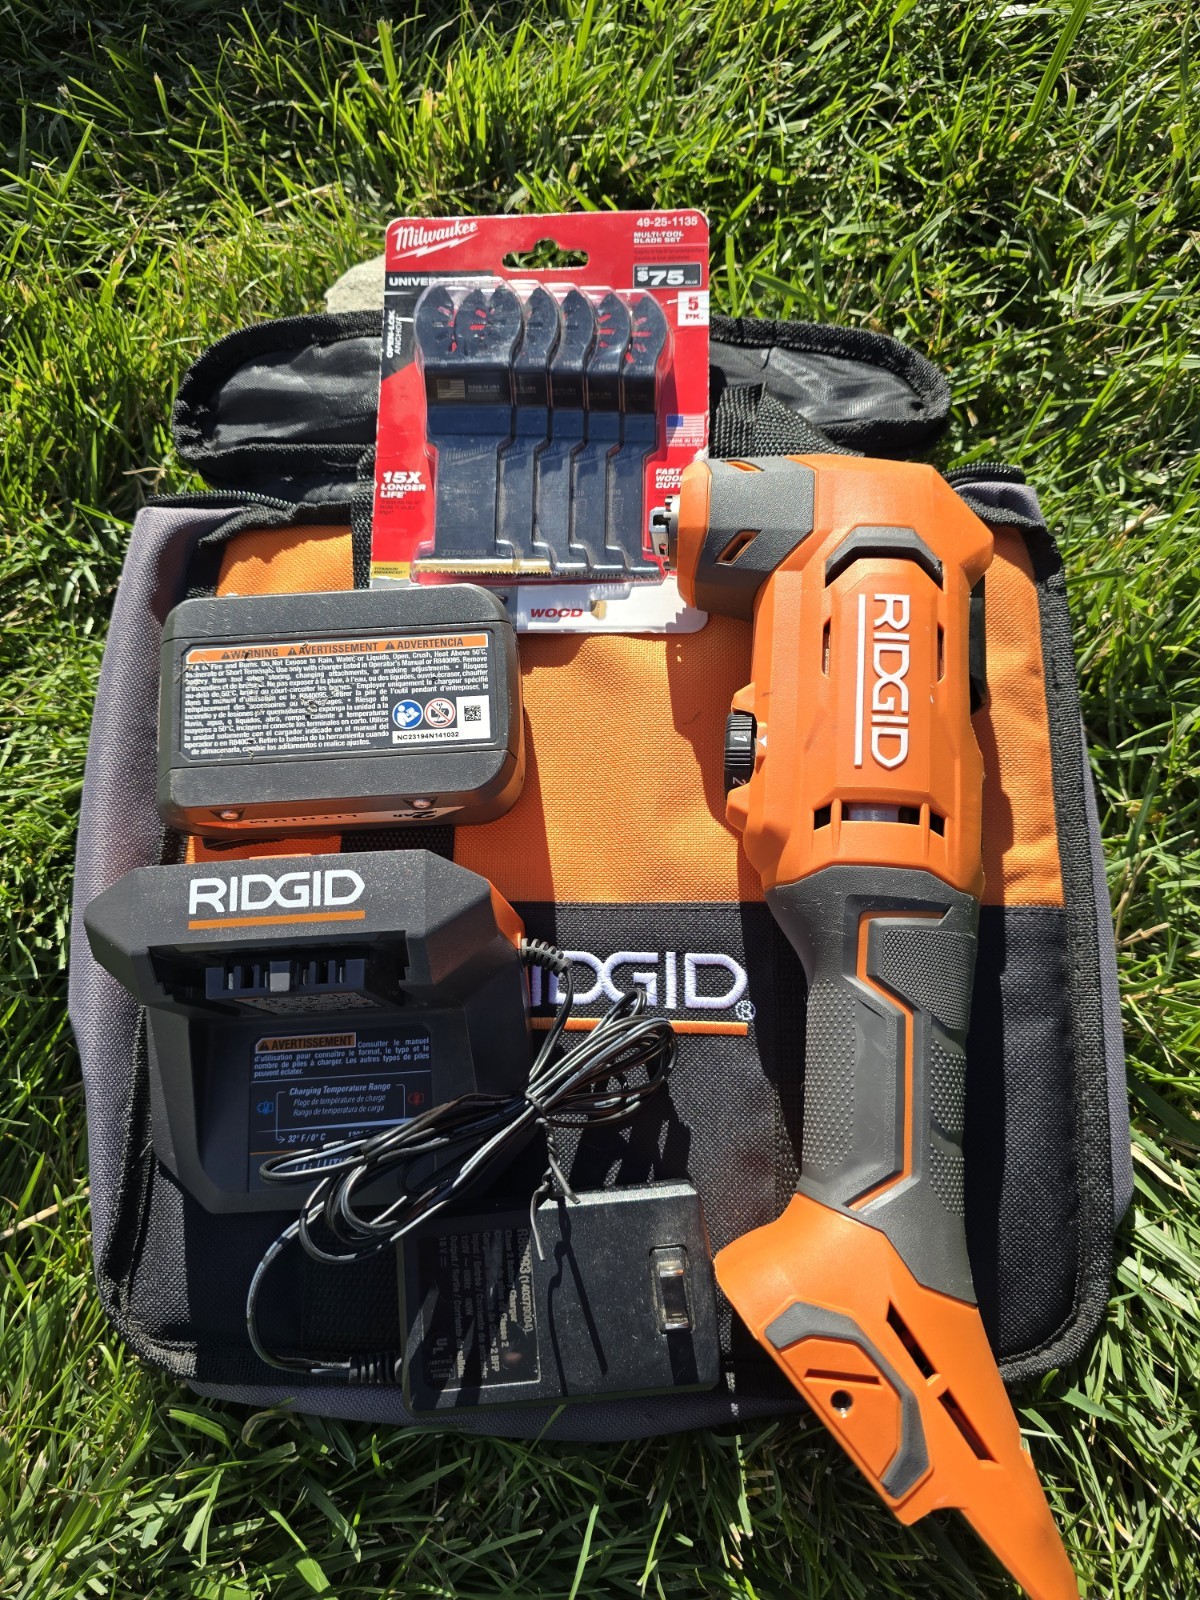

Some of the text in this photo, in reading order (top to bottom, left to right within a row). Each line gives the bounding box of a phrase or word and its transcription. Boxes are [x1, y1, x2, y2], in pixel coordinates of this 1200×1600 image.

[636, 216, 698, 227] 49-25-1135
[392, 221, 478, 252] Milwaukee
[687, 296, 699, 311] 5
[383, 471, 422, 484] 15X
[380, 483, 427, 492] LONGER
[530, 608, 584, 618] WOOD
[397, 638, 463, 649] ADVERTENCIA
[296, 671, 324, 679] changing
[329, 669, 369, 678] attachments,
[411, 664, 450, 673] adjustments.
[369, 660, 400, 669] Operator's
[870, 592, 910, 769] RIDGID
[347, 710, 388, 719] temperaturas
[346, 739, 370, 747] ajustes.
[397, 732, 459, 740] NC23194N141032
[733, 735, 748, 743] 1
[732, 776, 747, 786] 2
[188, 869, 365, 915] RIDGID
[531, 950, 748, 1010] IDGID
[272, 1036, 352, 1050] AVERTISSEMENT
[358, 1040, 388, 1048] Consulter
[255, 1053, 292, 1062] d'utilisation
[396, 1046, 409, 1054] type
[292, 1060, 307, 1069] piles
[318, 1058, 343, 1067] charger.
[383, 1054, 400, 1063] types
[414, 1052, 429, 1061] piles
[290, 1082, 391, 1097] Charging Temperature Range
[294, 1098, 310, 1108] Plage
[365, 1093, 386, 1103] charge
[294, 1108, 312, 1118] Rango
[507, 1289, 519, 1322] Charger
[455, 1350, 467, 1379] salida:
